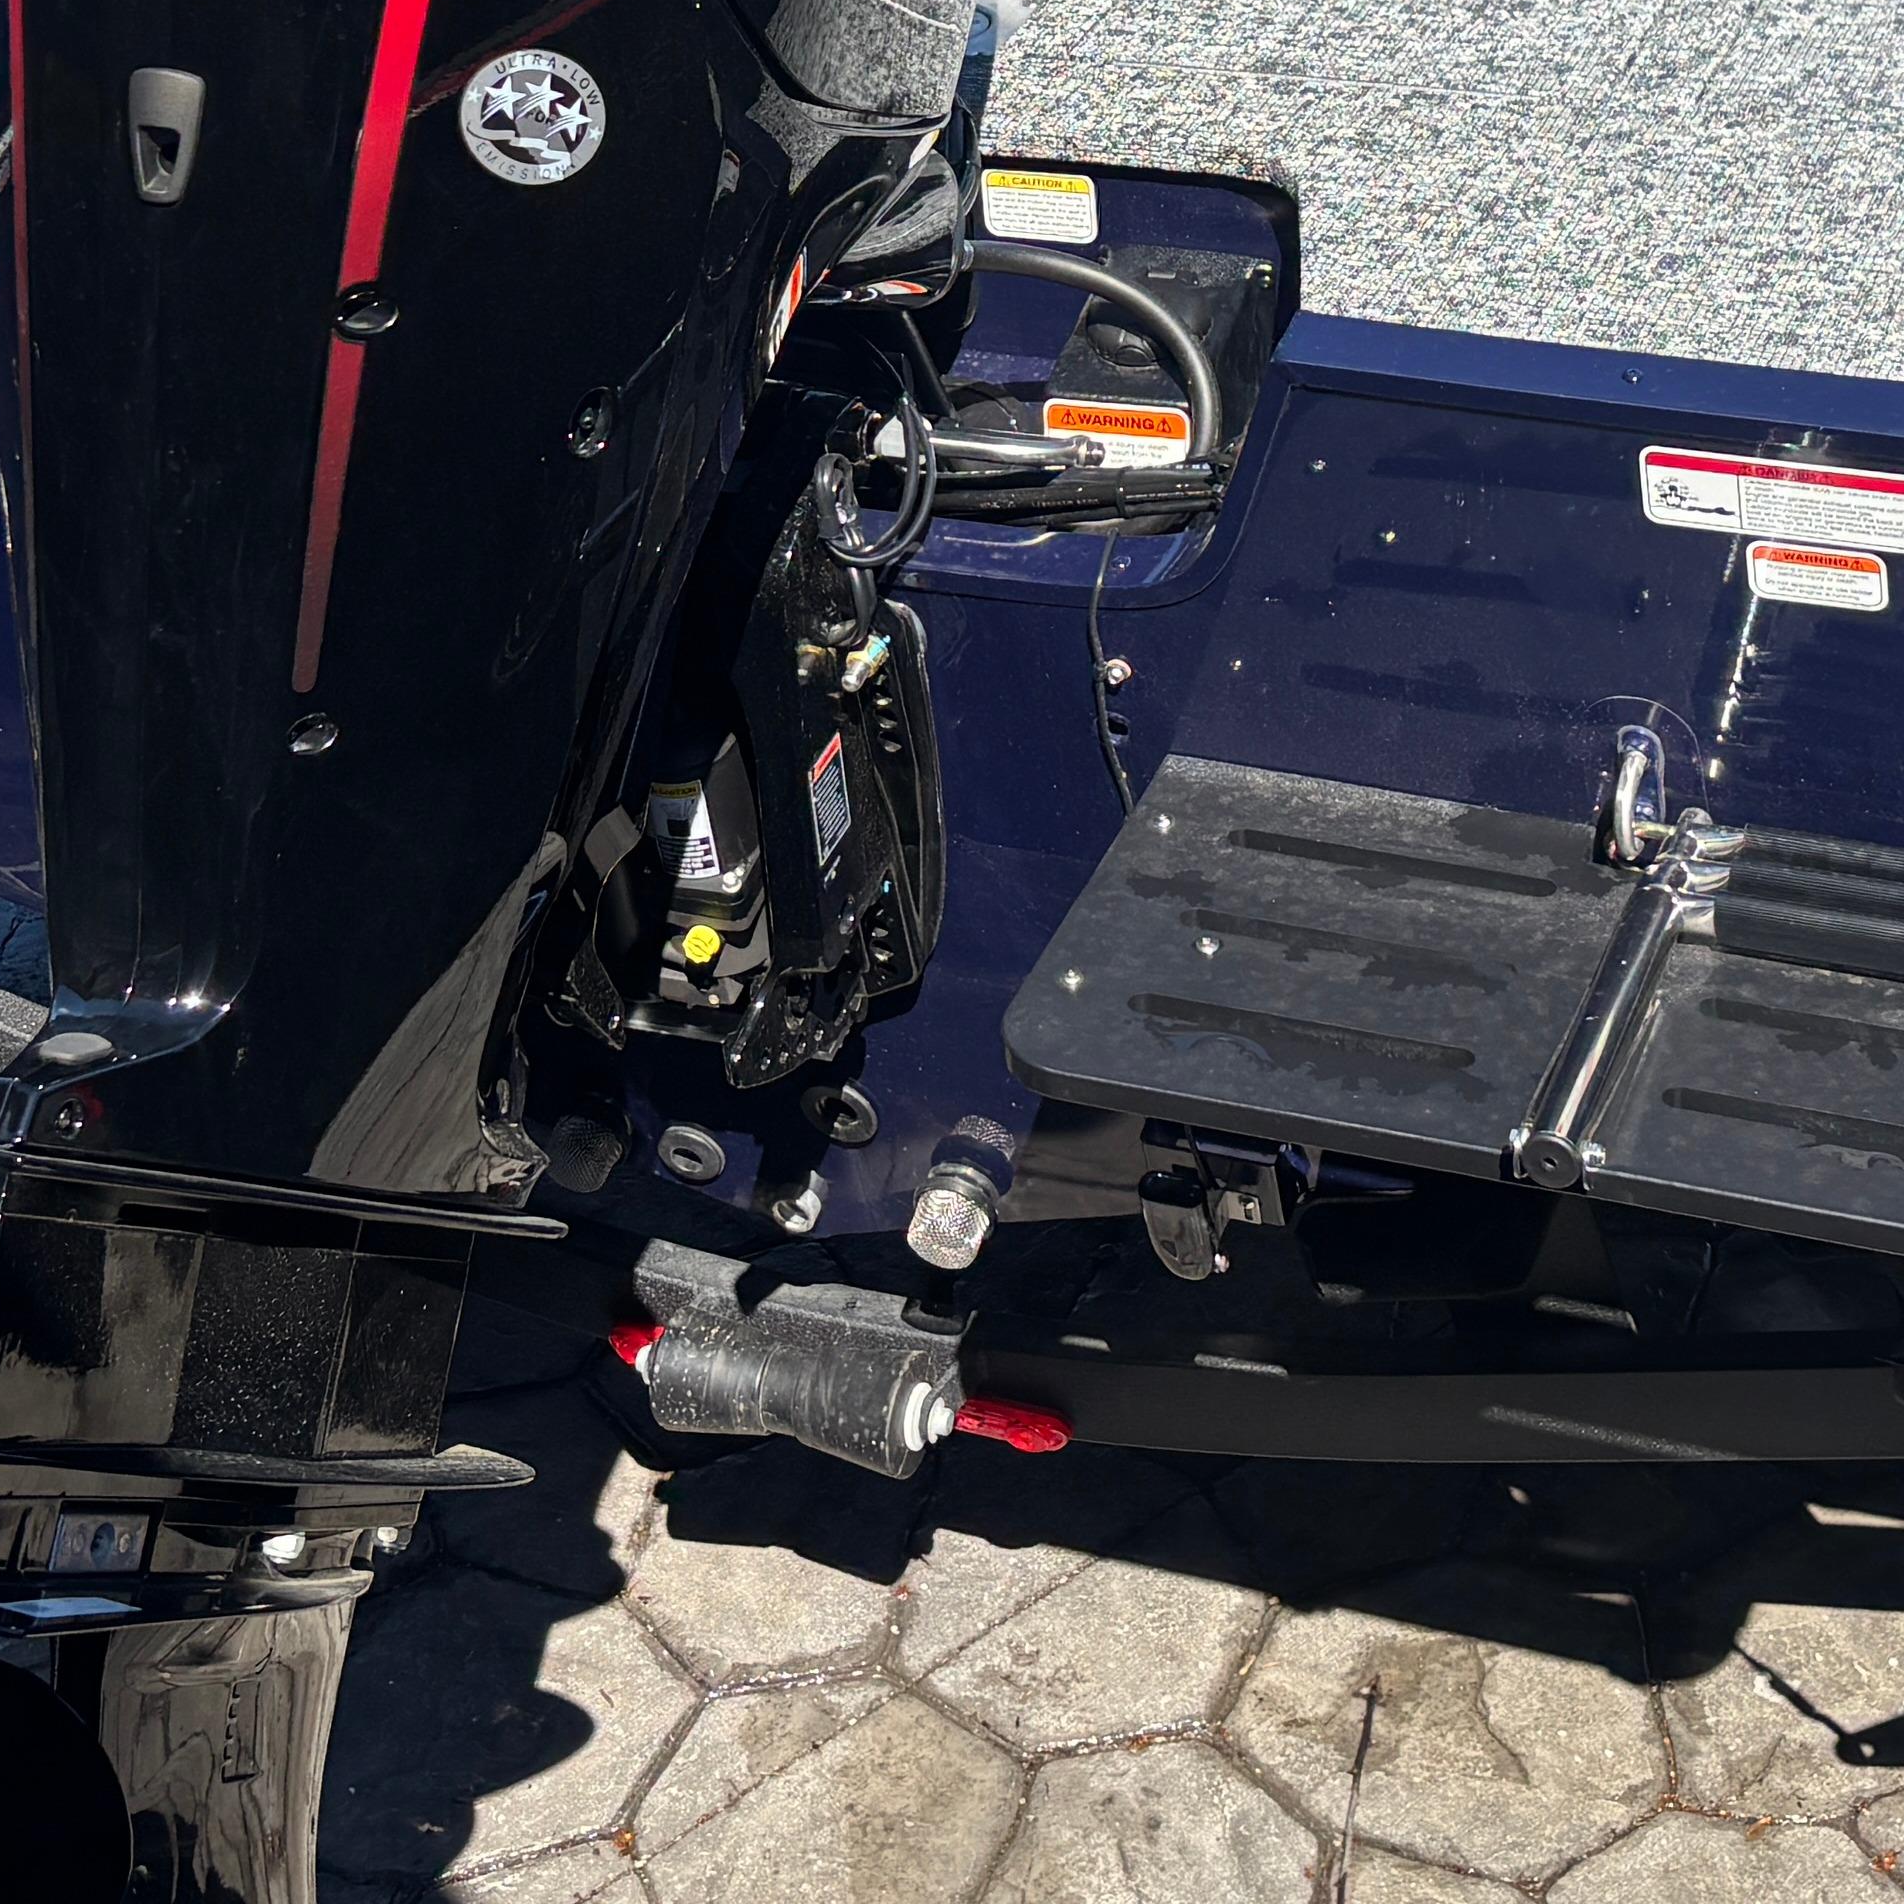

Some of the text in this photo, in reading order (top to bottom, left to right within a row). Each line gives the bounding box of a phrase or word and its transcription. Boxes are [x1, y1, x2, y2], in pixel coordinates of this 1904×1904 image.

[494, 53, 601, 107] ULTRA LOW
[1012, 177, 1063, 189] CAUTION
[1078, 413, 1155, 430] WARNING
[1784, 552, 1849, 568] WARNING
